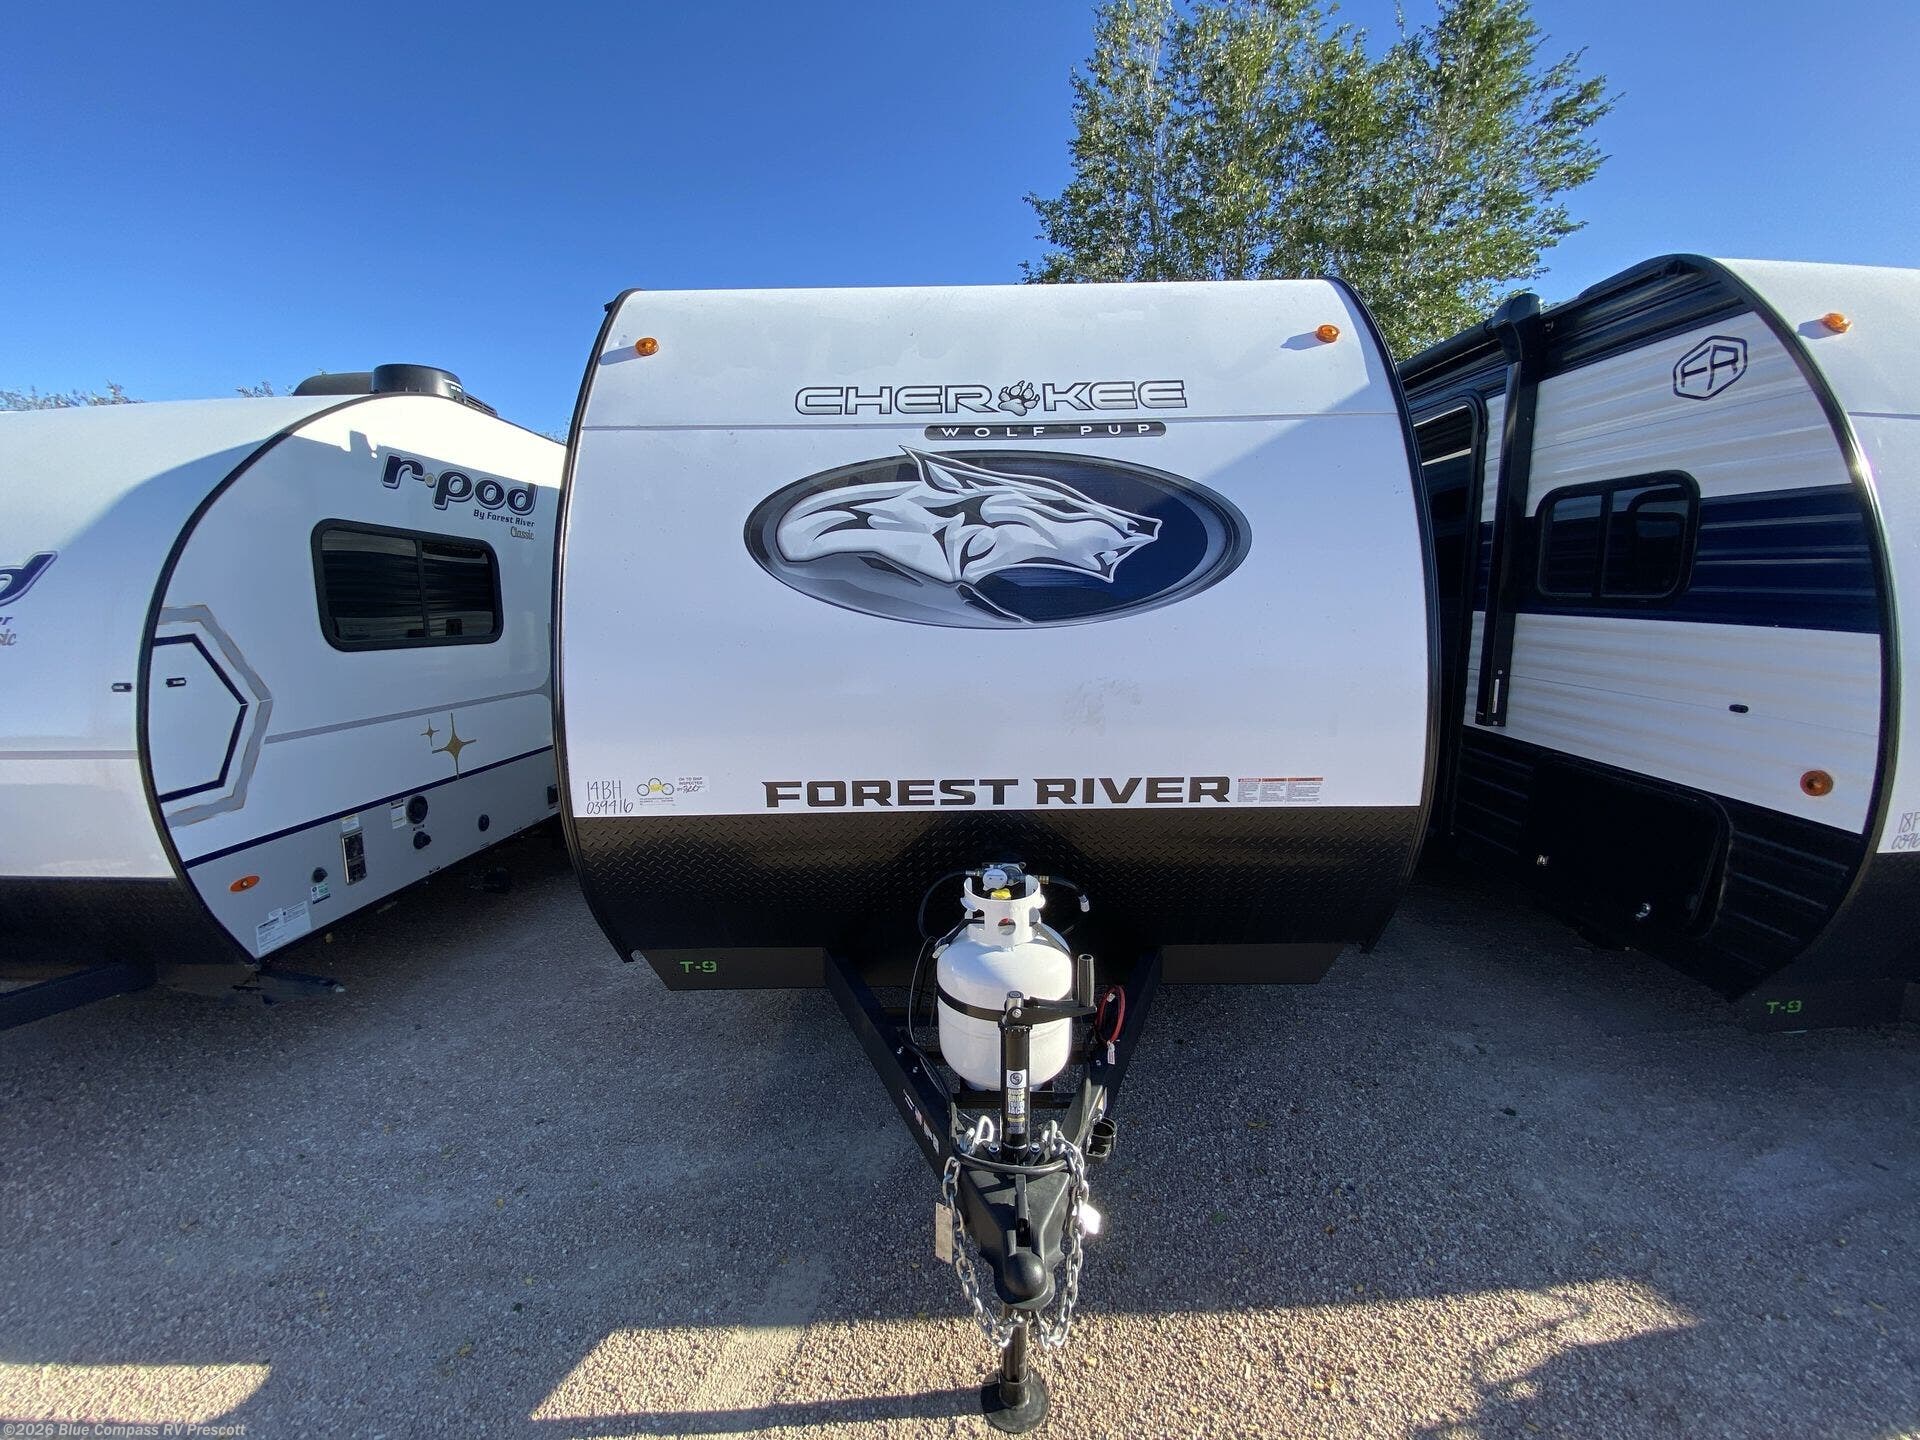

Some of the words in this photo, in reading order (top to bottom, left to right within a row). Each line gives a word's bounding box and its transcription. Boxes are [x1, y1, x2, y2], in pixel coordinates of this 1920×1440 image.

[941, 426, 1045, 439] WOLF
[1080, 424, 1151, 436] PUP
[473, 508, 485, 521] By
[487, 511, 514, 524] Forest
[515, 517, 536, 528] River
[510, 526, 536, 541] Classic
[587, 779, 622, 801] 14BH
[761, 778, 1019, 808] FOREST
[1032, 776, 1231, 806] RIVER
[680, 960, 717, 973] T-9
[1766, 1000, 1802, 1014] T-9
